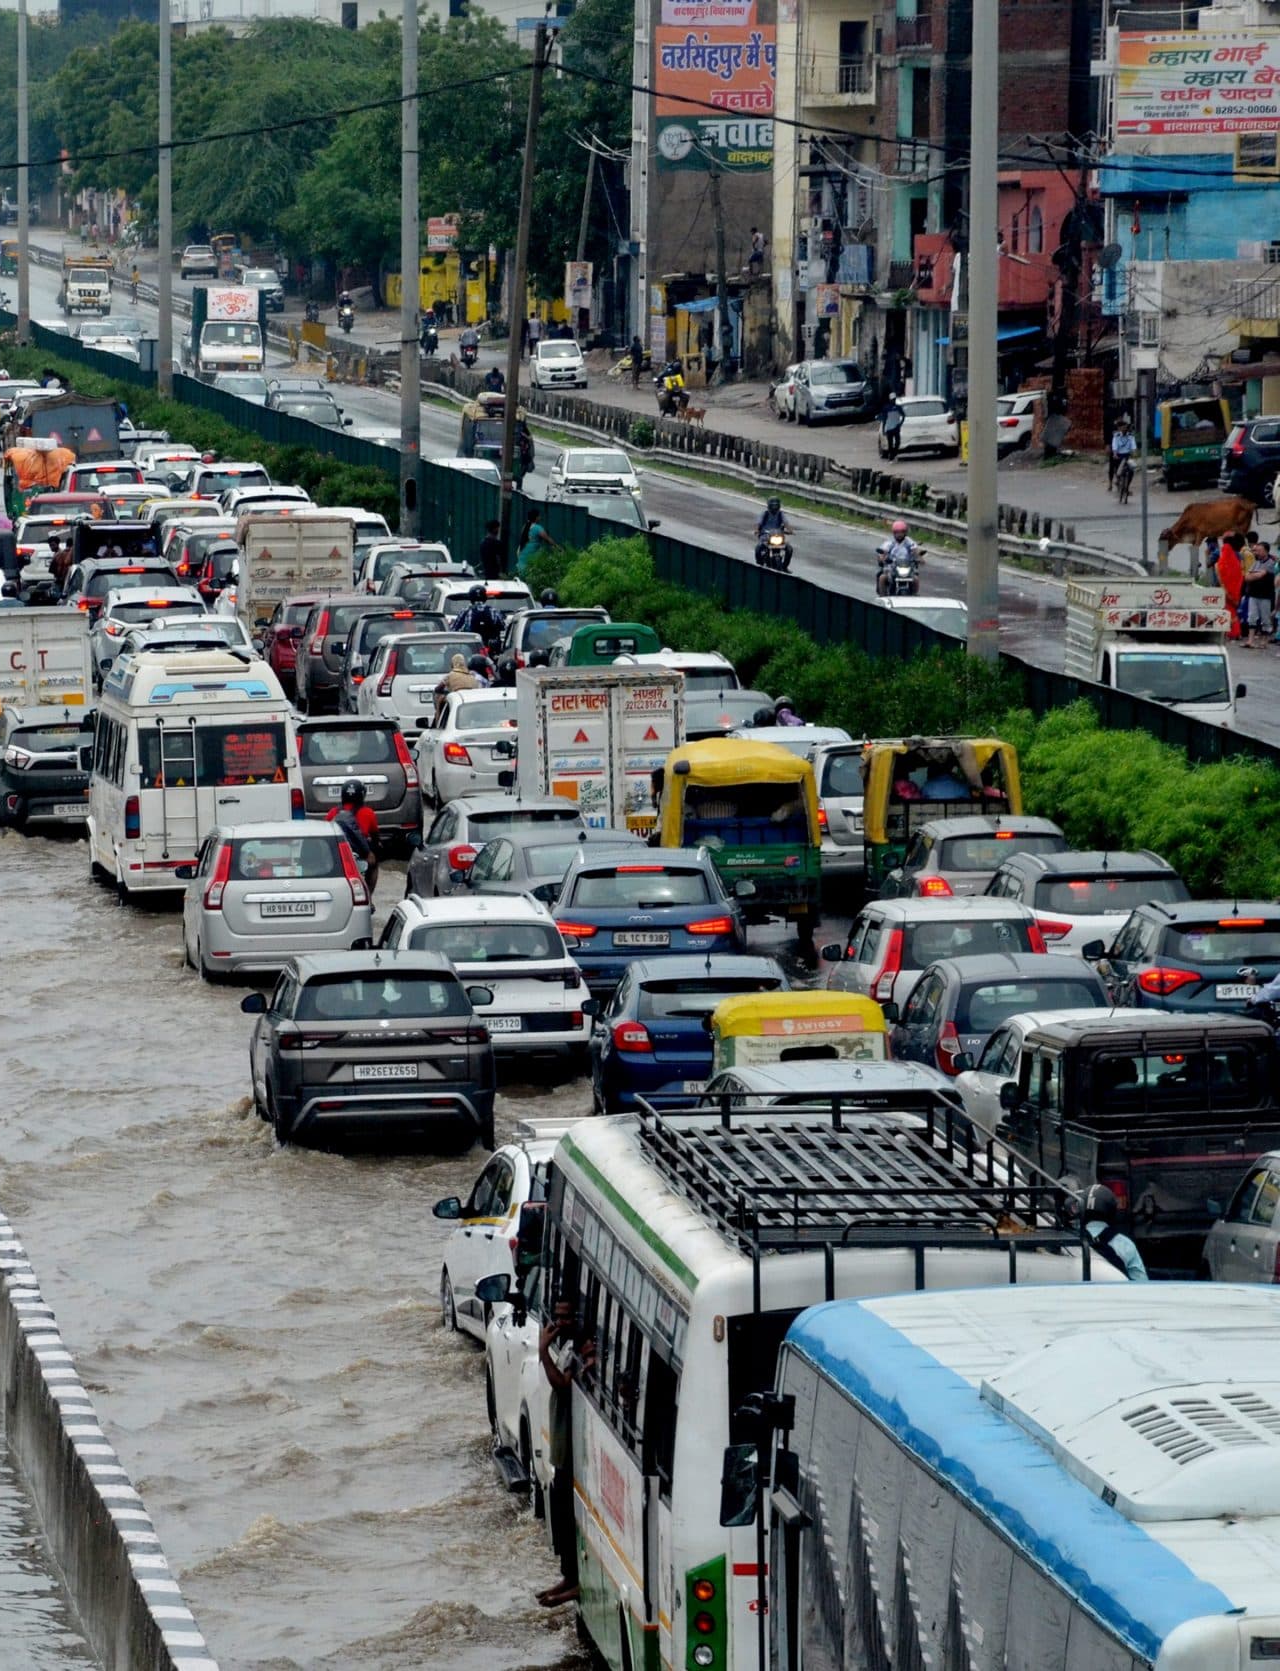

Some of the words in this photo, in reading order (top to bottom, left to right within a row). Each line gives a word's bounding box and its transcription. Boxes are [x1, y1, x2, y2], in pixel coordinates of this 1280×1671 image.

[661, 33, 743, 79] नरसिंहपुर
[797, 1020, 843, 1031] SWIGGY
[359, 1065, 417, 1077] HR26EX2656
